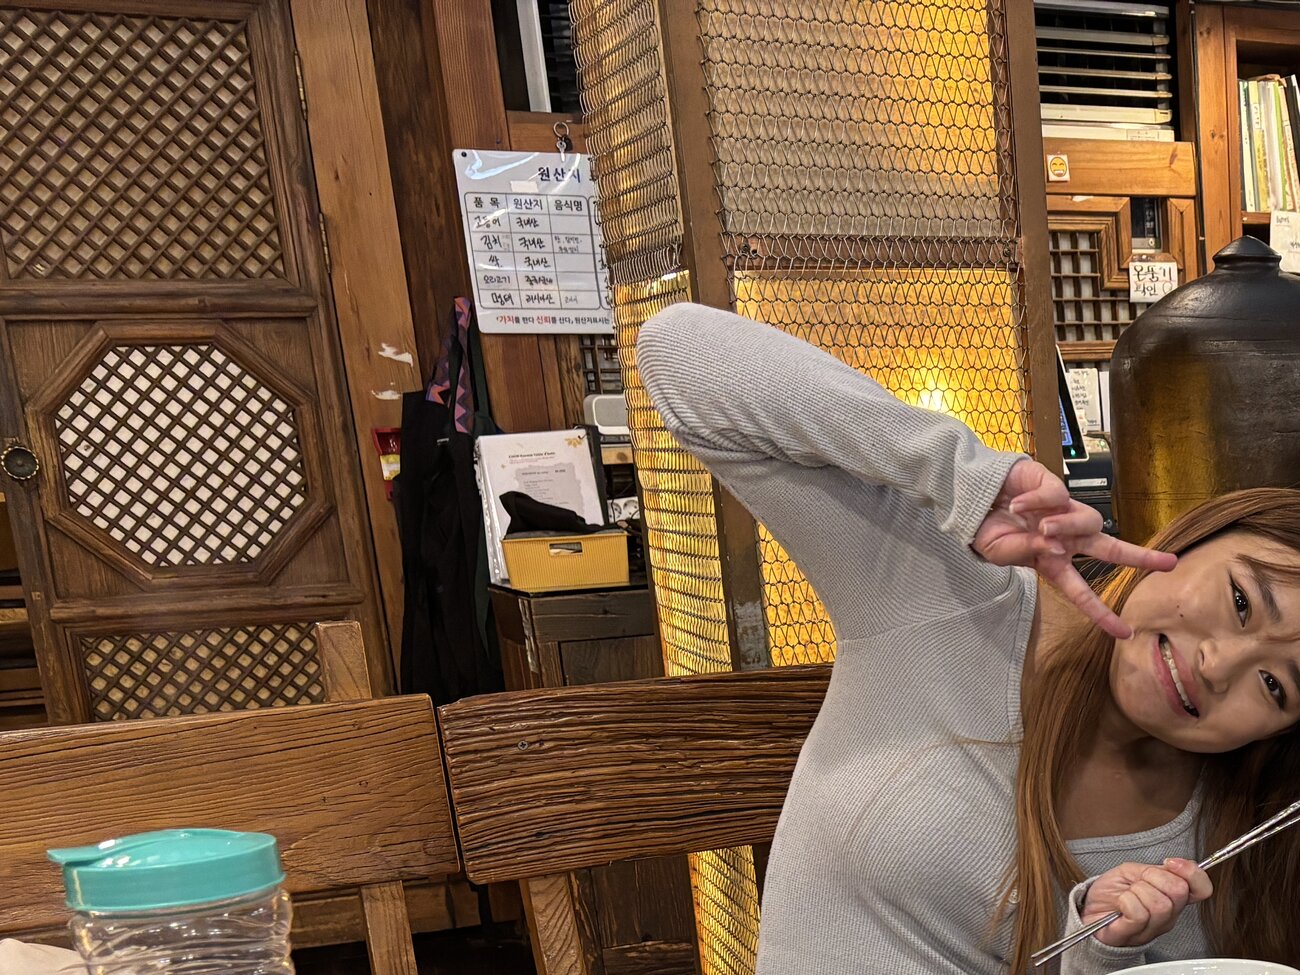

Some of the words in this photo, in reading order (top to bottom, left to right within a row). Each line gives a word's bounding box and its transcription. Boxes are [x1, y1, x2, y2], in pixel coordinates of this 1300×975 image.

[513, 198, 543, 211] 원산지
[554, 200, 583, 212] 음식명
[515, 216, 540, 229] 국내산
[480, 235, 503, 250] 김치
[518, 237, 546, 251] 국내산
[523, 256, 551, 270] 국내산
[483, 275, 511, 285] 오리고기
